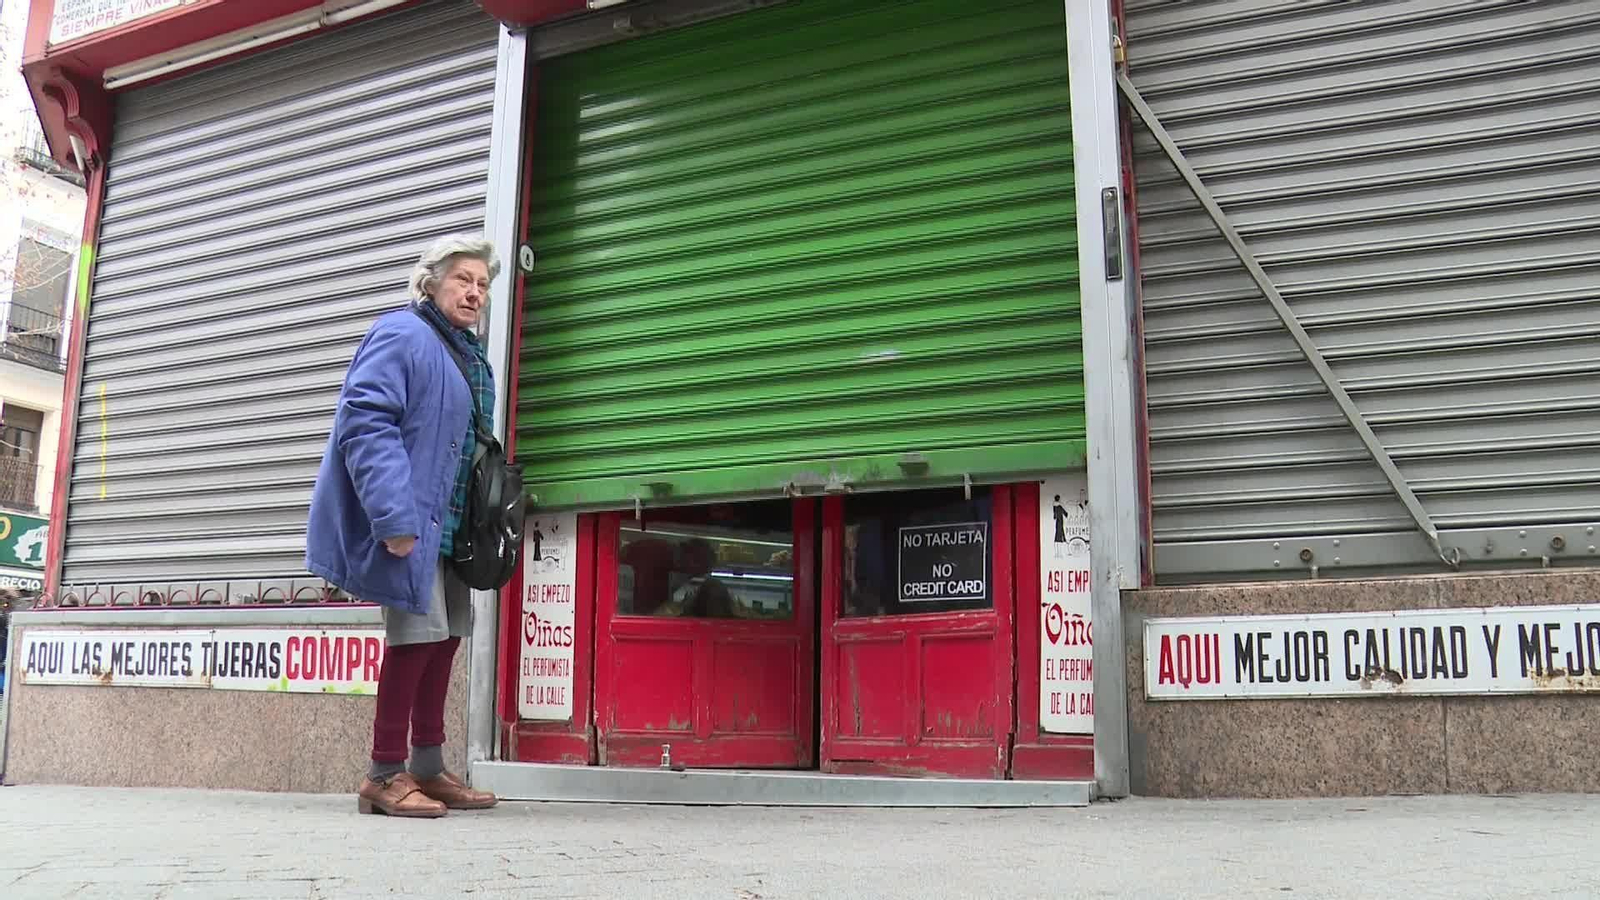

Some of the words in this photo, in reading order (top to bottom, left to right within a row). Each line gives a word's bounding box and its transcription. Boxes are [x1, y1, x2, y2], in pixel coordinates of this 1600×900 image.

[61, 7, 123, 37] SIEMPRE
[903, 534, 922, 548] NO
[925, 530, 984, 546] TARJETA
[932, 563, 952, 578] NO
[1047, 570, 1063, 593] ASI
[1068, 570, 1092, 593] EMP
[527, 584, 539, 603] ASI
[541, 584, 570, 603] EMPEZO
[903, 581, 946, 596] CREDIT
[947, 579, 983, 594] CARD
[523, 611, 572, 648] Viñas
[27, 641, 64, 677] AQUI
[72, 641, 102, 675] LAS
[111, 641, 193, 677] MEJORES
[201, 641, 281, 679] TIJERAS
[286, 636, 387, 682] COMPR
[1159, 633, 1220, 689] AQUI
[1234, 631, 1330, 684] MEJOR
[1344, 625, 1468, 682] CALIDAD
[1482, 624, 1501, 678] Y
[1518, 621, 1600, 678] MEJO
[523, 657, 530, 676] EL
[533, 657, 570, 677] PERFUMISTA
[1046, 658, 1056, 680] EL
[526, 685, 534, 704] DE
[536, 685, 544, 705] LA
[546, 686, 566, 706] CALLE
[1051, 692, 1061, 714] DE
[1066, 692, 1076, 715] LA
